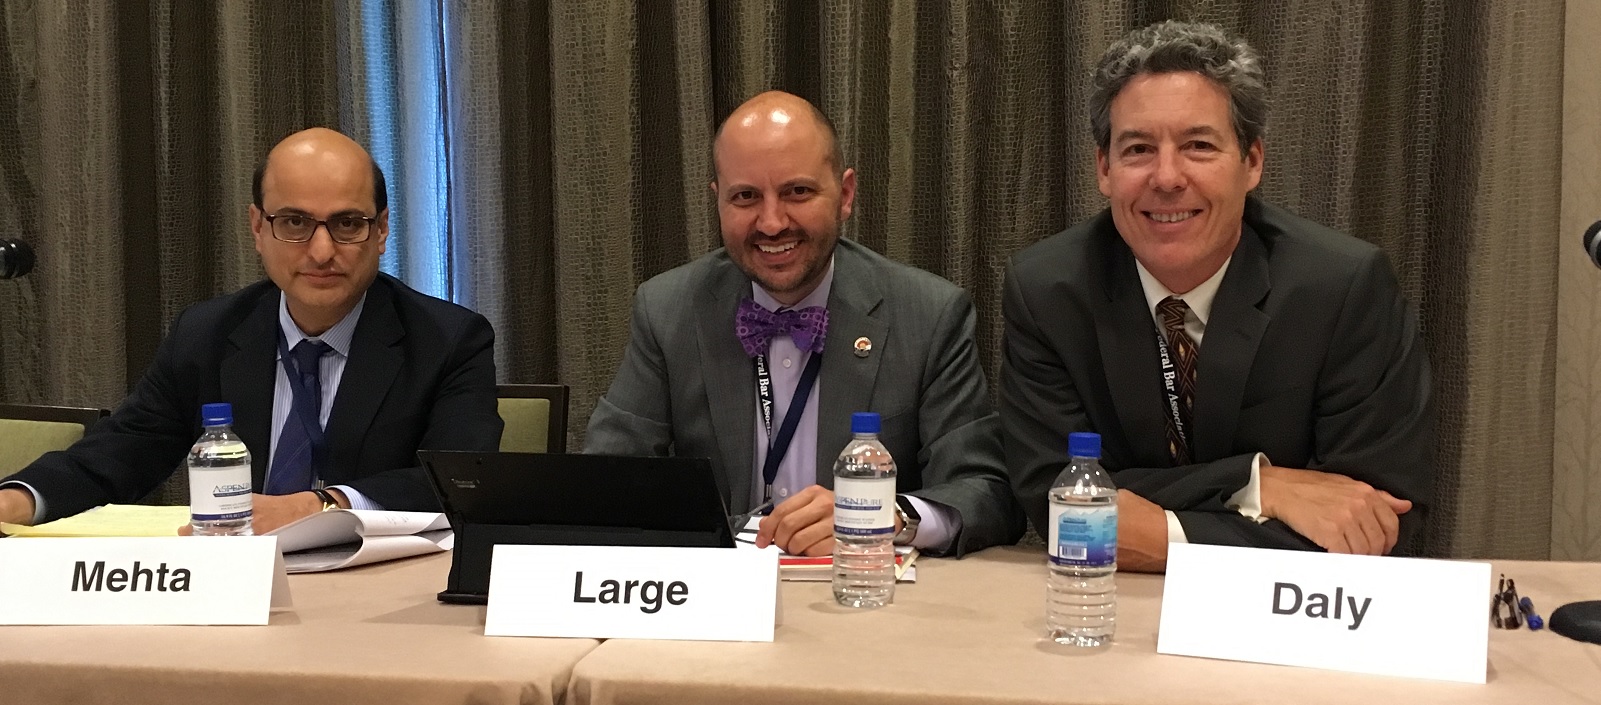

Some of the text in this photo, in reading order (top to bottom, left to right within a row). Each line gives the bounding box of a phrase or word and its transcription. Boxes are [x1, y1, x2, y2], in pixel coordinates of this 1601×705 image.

[759, 377, 770, 397] Bar
[1163, 371, 1176, 392] Bar
[71, 561, 191, 593] Mehta
[573, 571, 689, 614] Large
[1271, 582, 1372, 630] Daly
